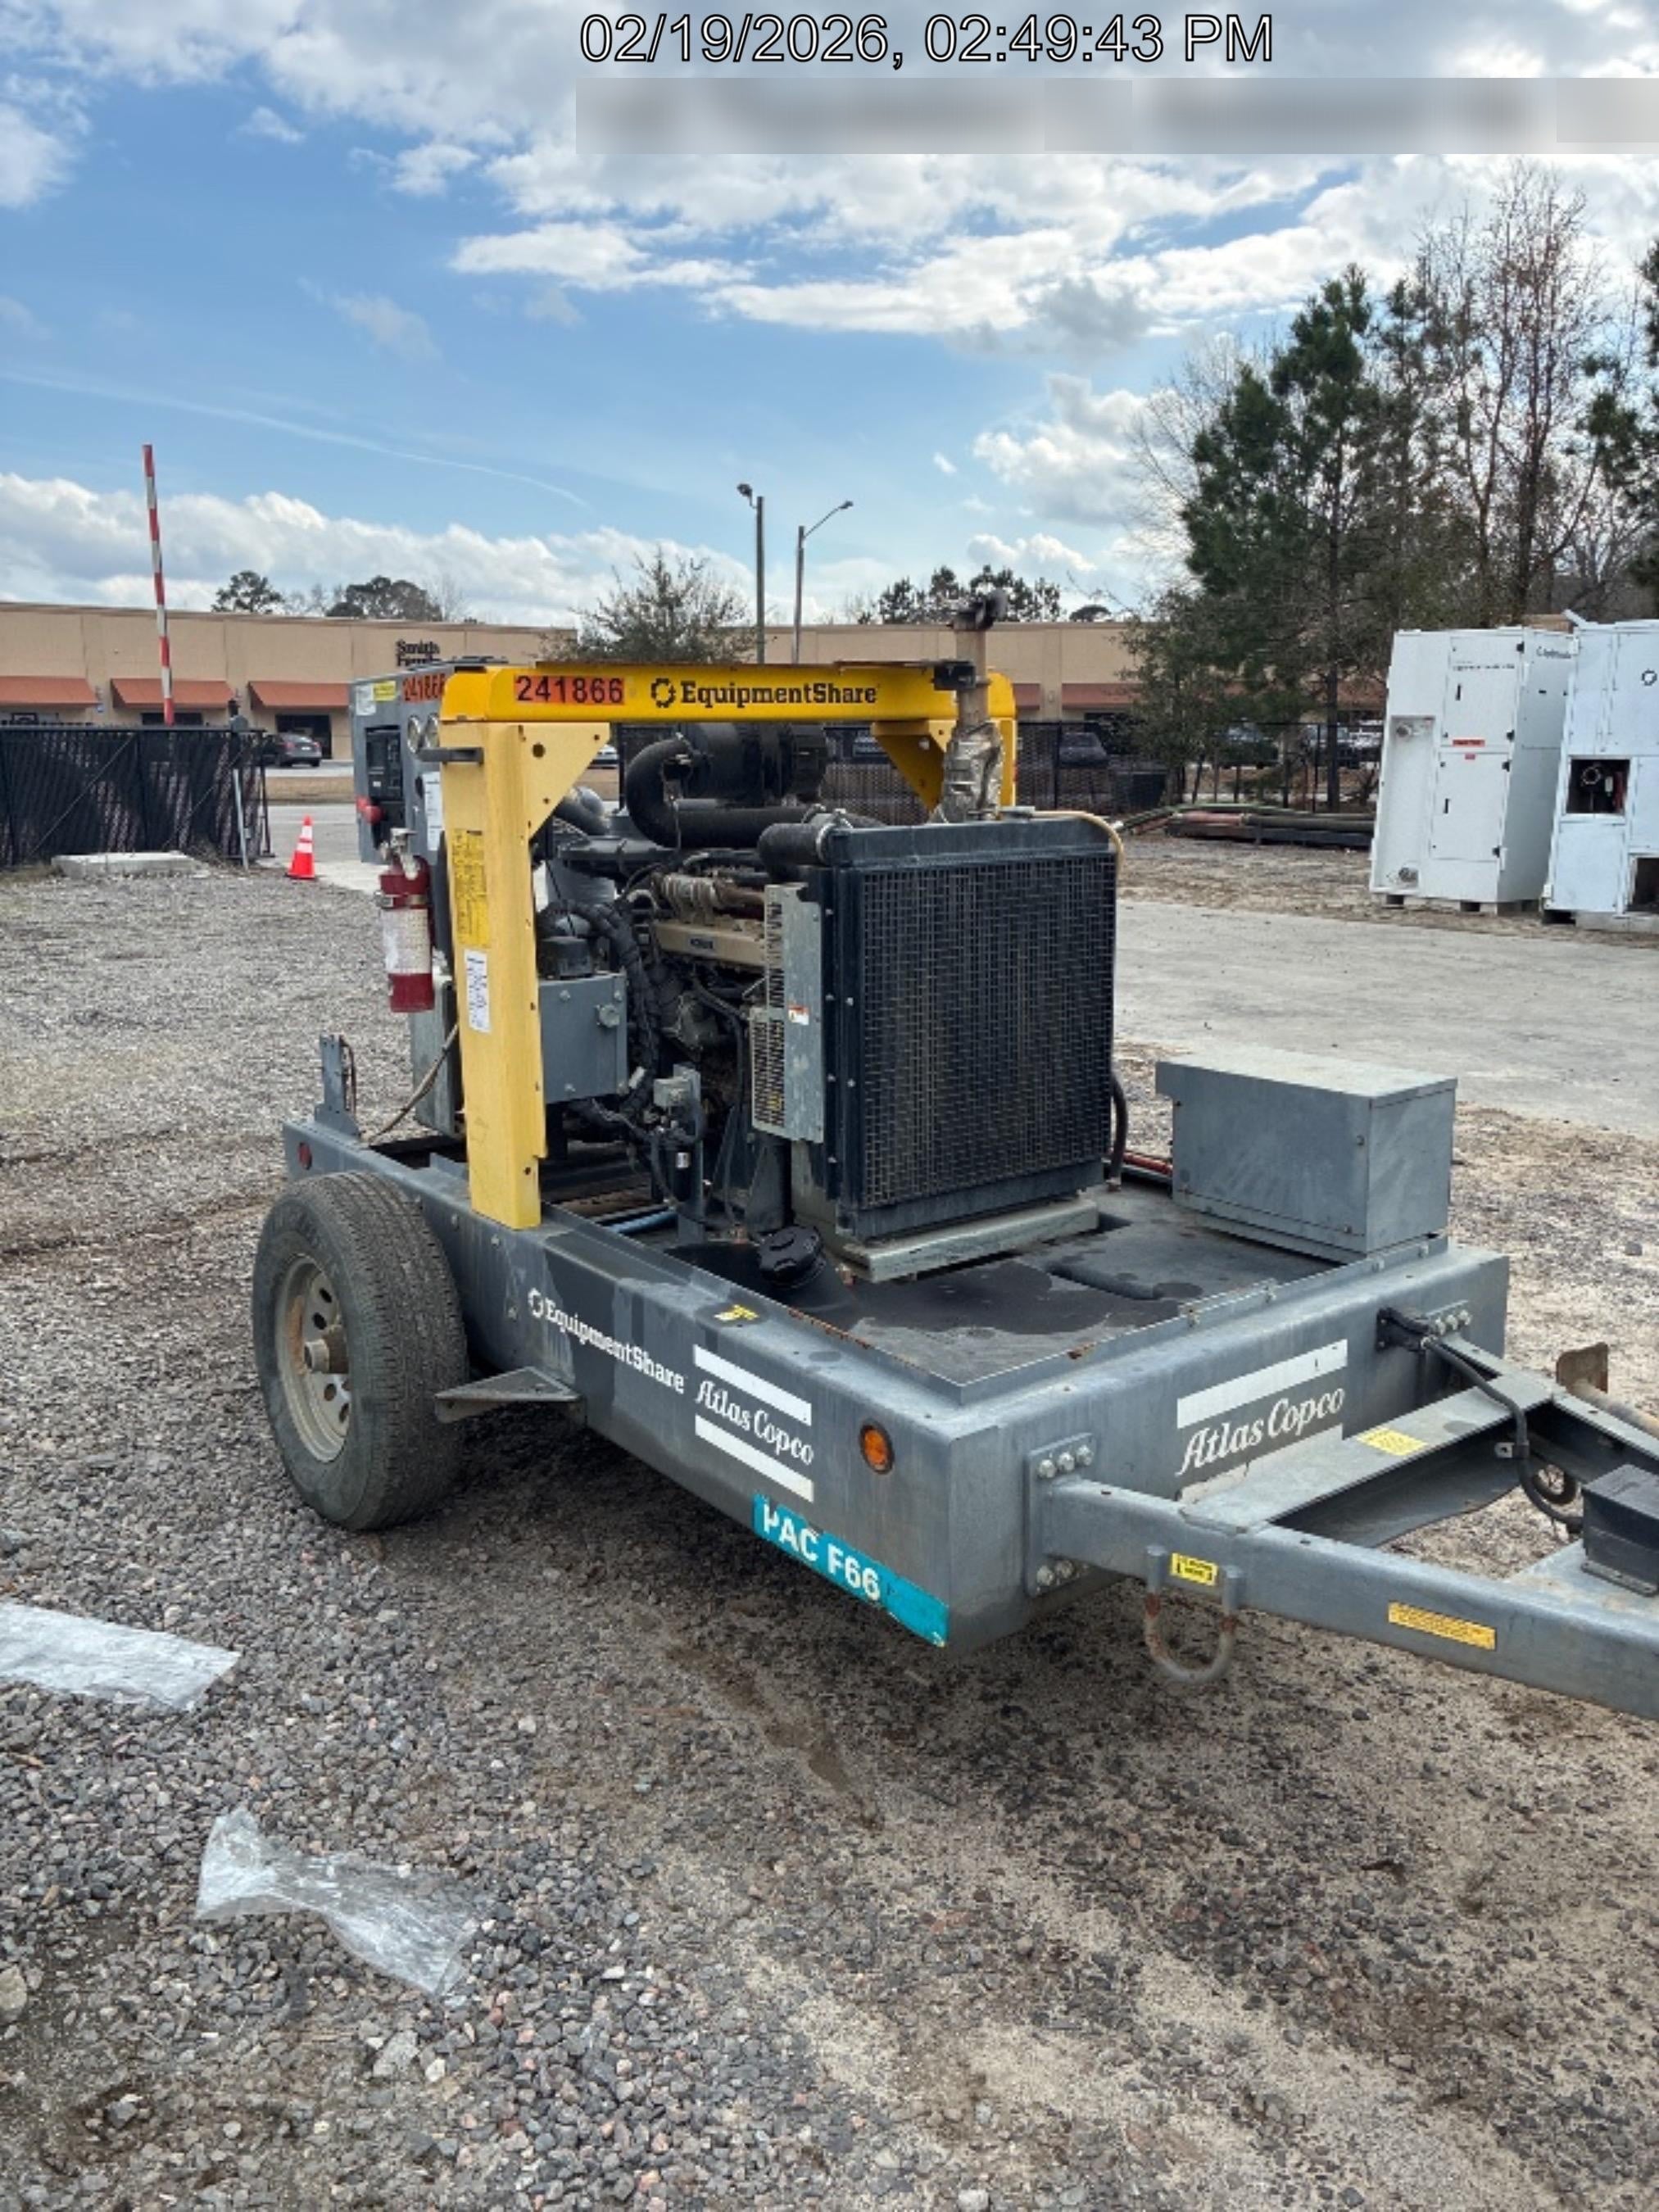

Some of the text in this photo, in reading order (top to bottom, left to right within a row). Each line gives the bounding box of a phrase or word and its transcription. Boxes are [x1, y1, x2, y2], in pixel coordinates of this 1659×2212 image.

[516, 675, 624, 704] 241866
[680, 681, 877, 708] EquipmentShare
[544, 1297, 686, 1394] EquipmentShare
[696, 1380, 814, 1466] Atlas Copco
[1174, 1387, 1346, 1477] Atlas Copco
[827, 1543, 881, 1601] F66
